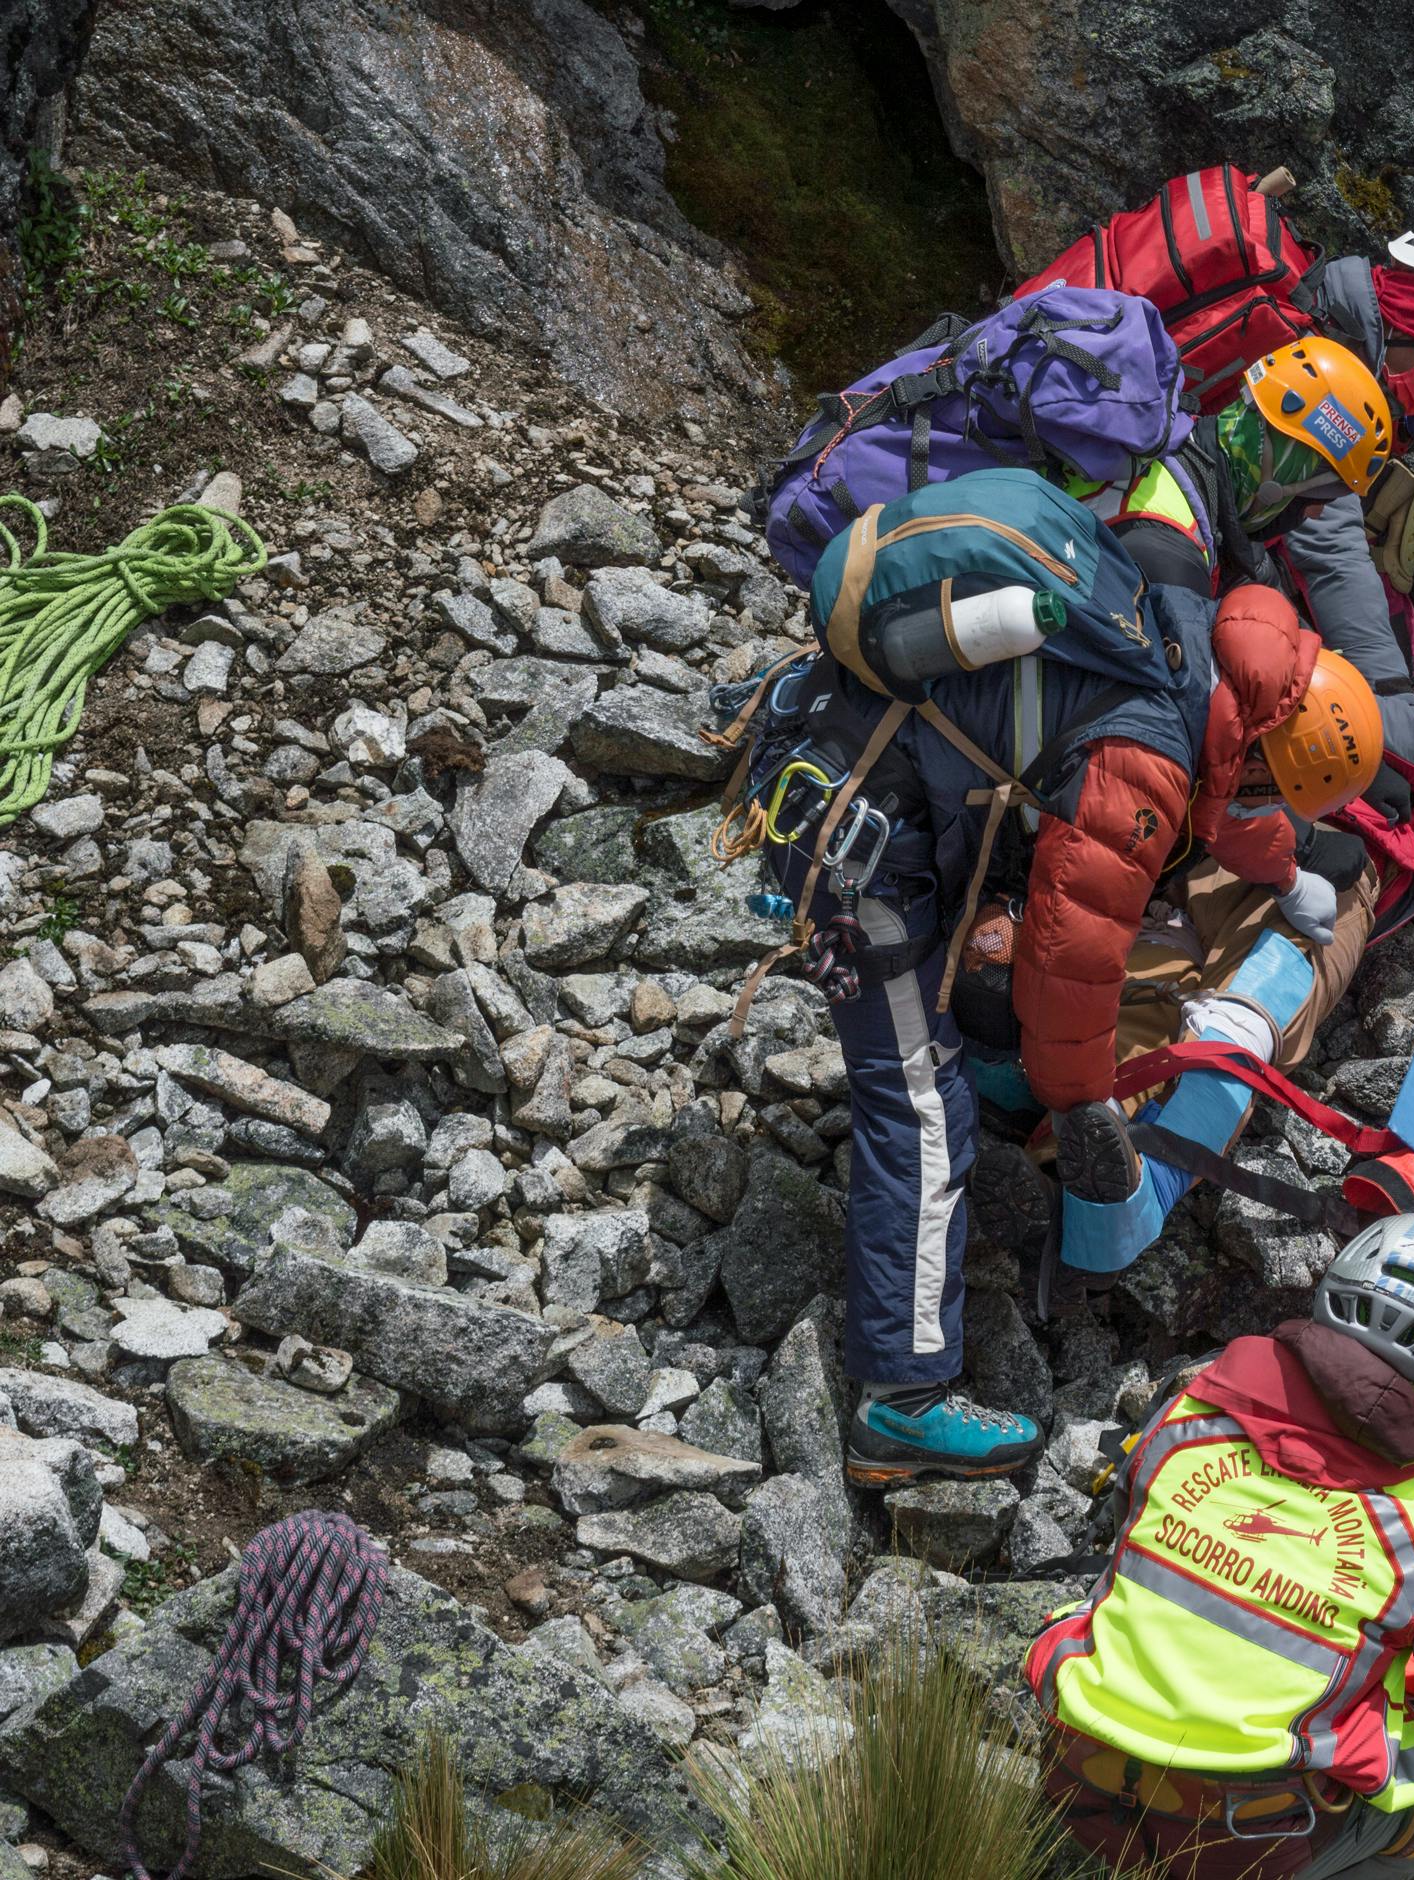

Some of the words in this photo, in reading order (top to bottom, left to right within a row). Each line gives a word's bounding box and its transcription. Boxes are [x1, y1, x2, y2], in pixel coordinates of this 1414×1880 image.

[1314, 416, 1347, 449] PRESS
[1320, 402, 1359, 442] PRENSA
[1330, 702, 1360, 765] CAMP
[1171, 1449, 1252, 1513] RESCATE
[1327, 1497, 1368, 1600] MONTAÑA
[1154, 1513, 1255, 1587] SOCORRO
[1250, 1567, 1340, 1629] ANDINO
